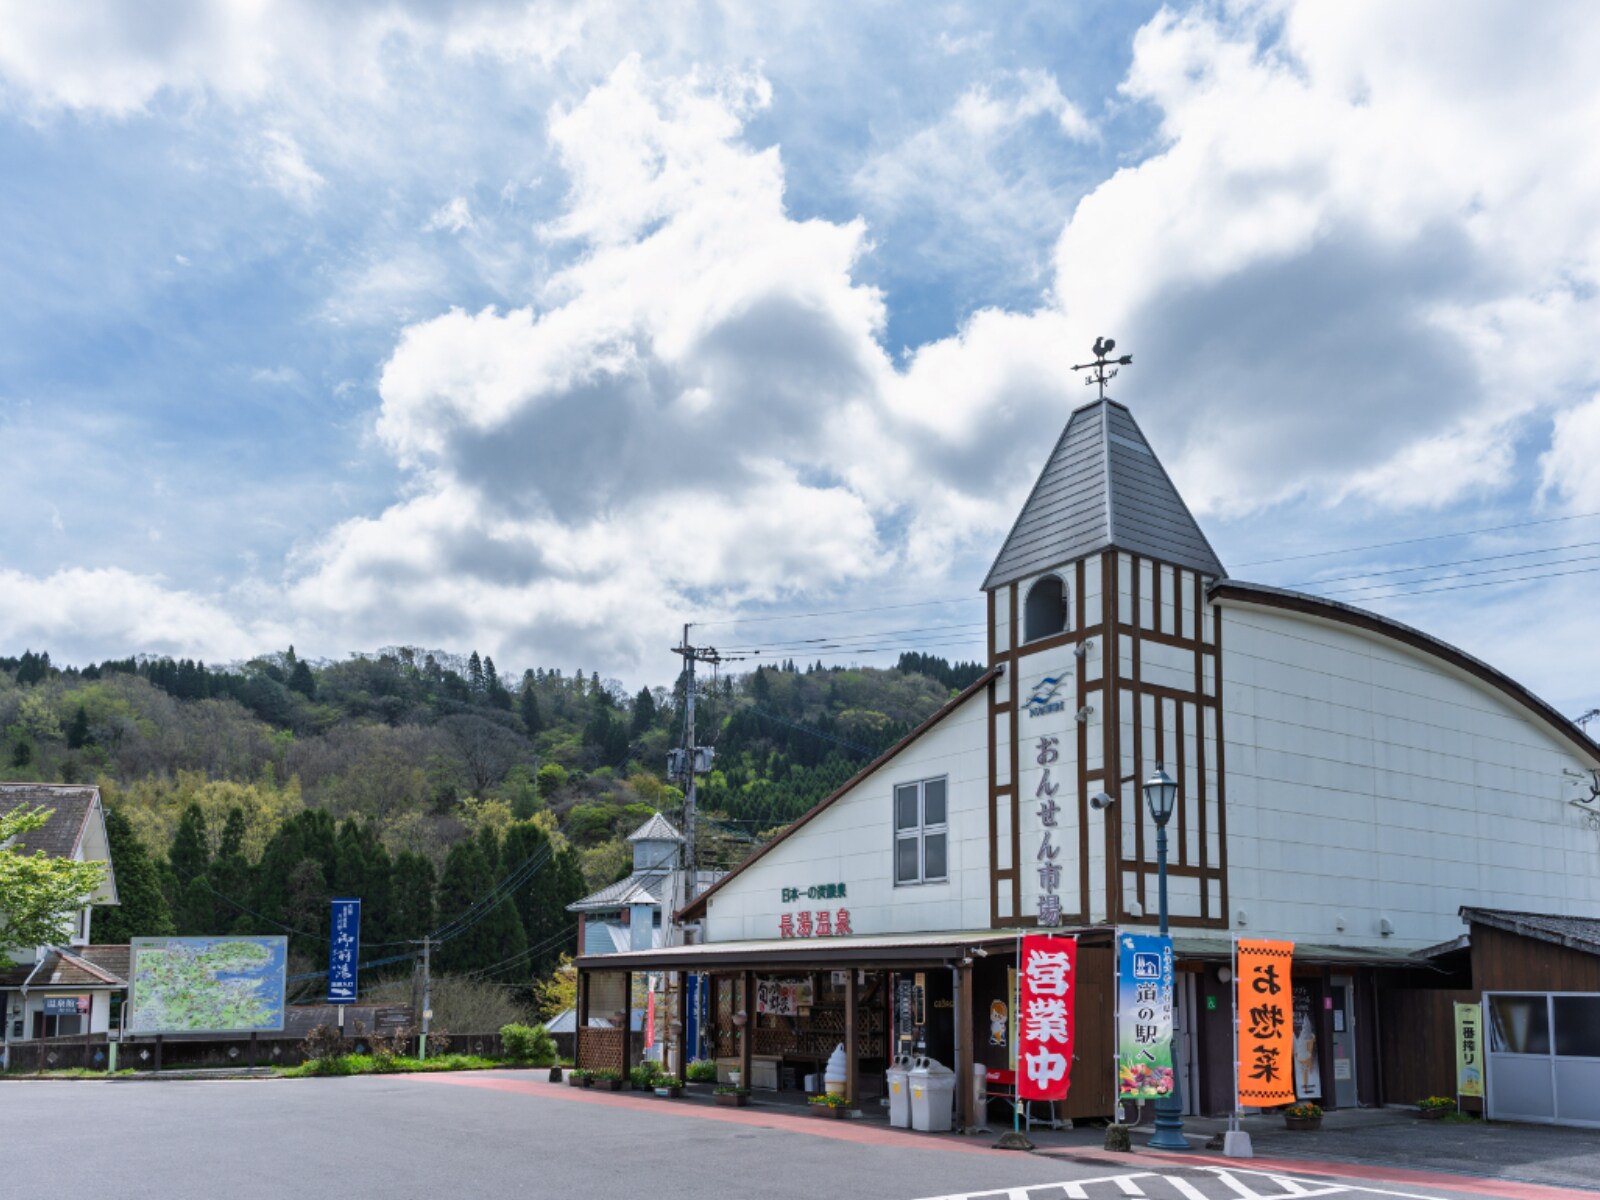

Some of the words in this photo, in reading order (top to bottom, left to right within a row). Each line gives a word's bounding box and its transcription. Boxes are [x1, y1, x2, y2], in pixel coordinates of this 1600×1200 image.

[1035, 736, 1063, 927] おんせん市場
[778, 907, 853, 938] 長湯温泉
[1025, 949, 1071, 1090] 営業中
[1135, 982, 1159, 1062] 道の駅へ
[1462, 1019, 1476, 1065] 一番搾り
